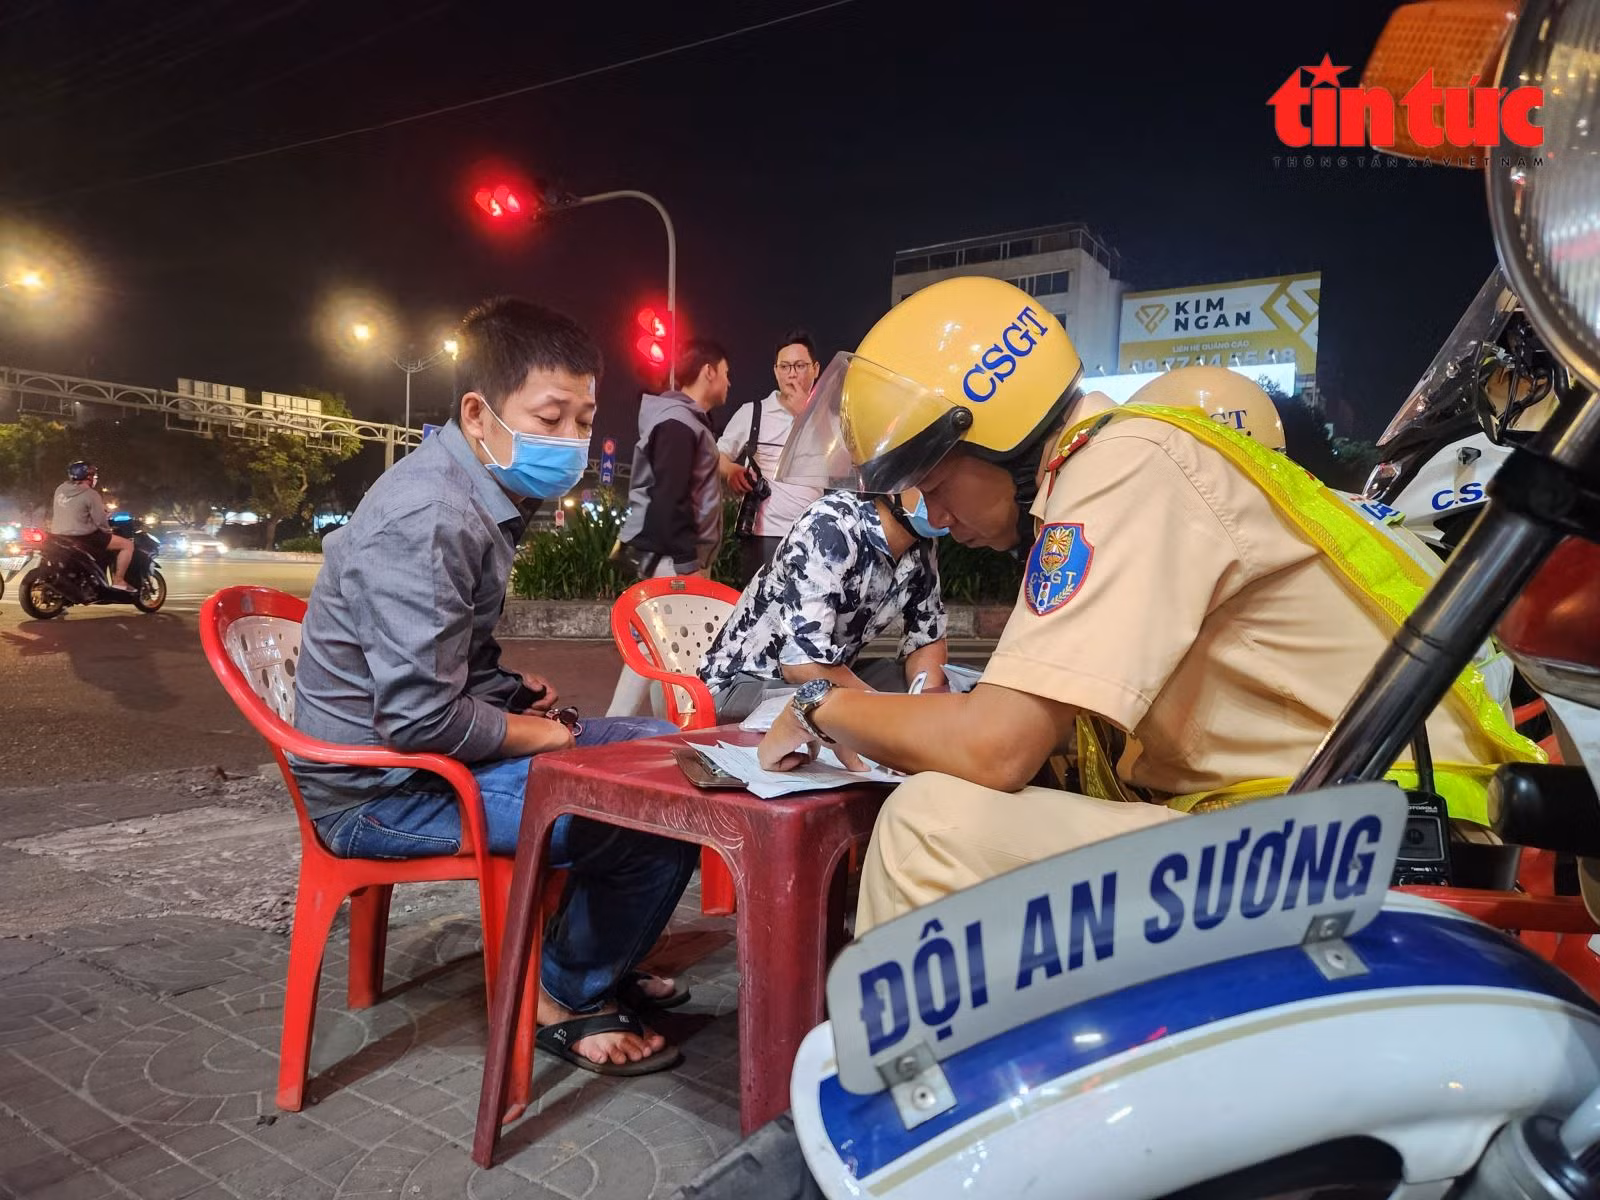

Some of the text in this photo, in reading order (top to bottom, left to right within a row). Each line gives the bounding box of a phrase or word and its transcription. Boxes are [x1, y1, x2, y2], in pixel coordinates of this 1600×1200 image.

[1175, 297, 1225, 315] KIM
[963, 306, 1048, 402] CSGT
[1030, 570, 1077, 585] CSGT
[860, 814, 1382, 1057] ĐỘI AN SƯƠNG
